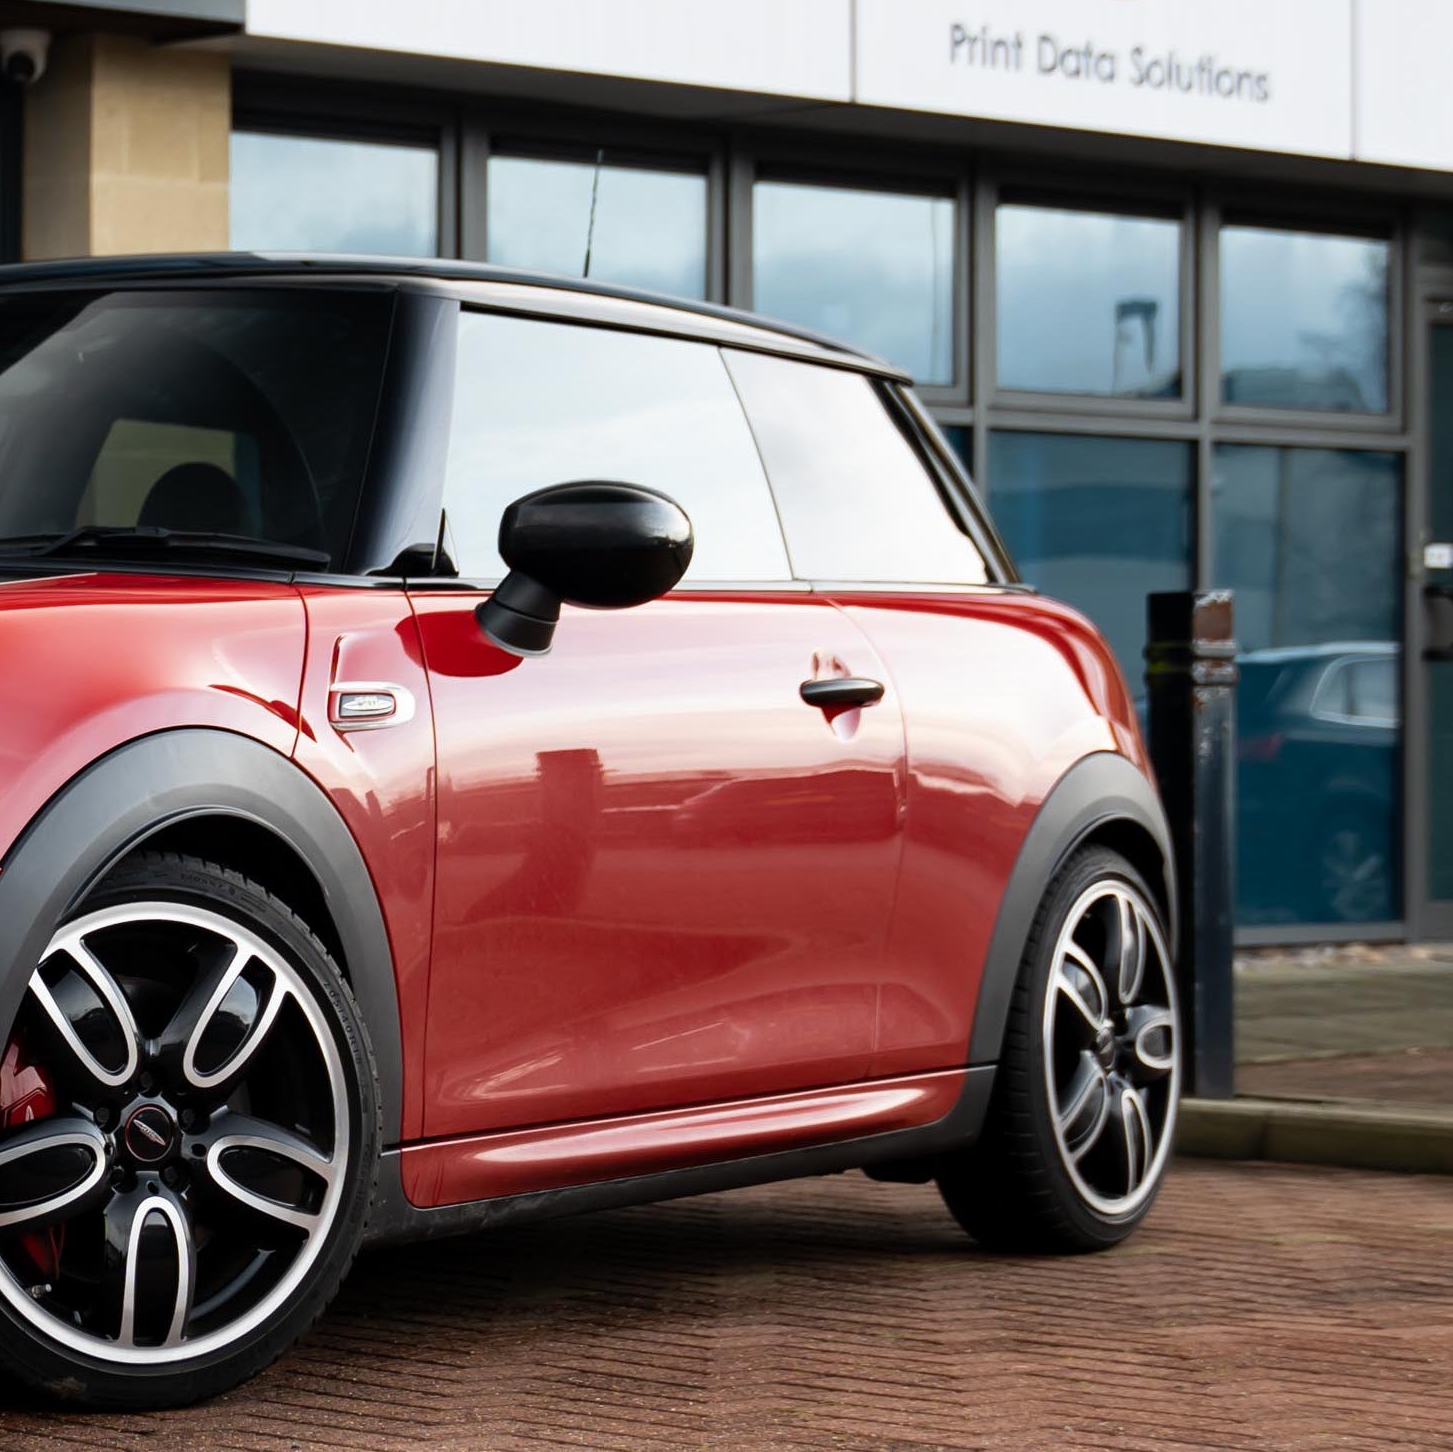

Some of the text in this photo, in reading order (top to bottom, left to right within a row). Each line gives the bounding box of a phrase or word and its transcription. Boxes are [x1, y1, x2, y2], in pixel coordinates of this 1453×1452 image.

[949, 22, 1271, 103] Print Data Solutions
